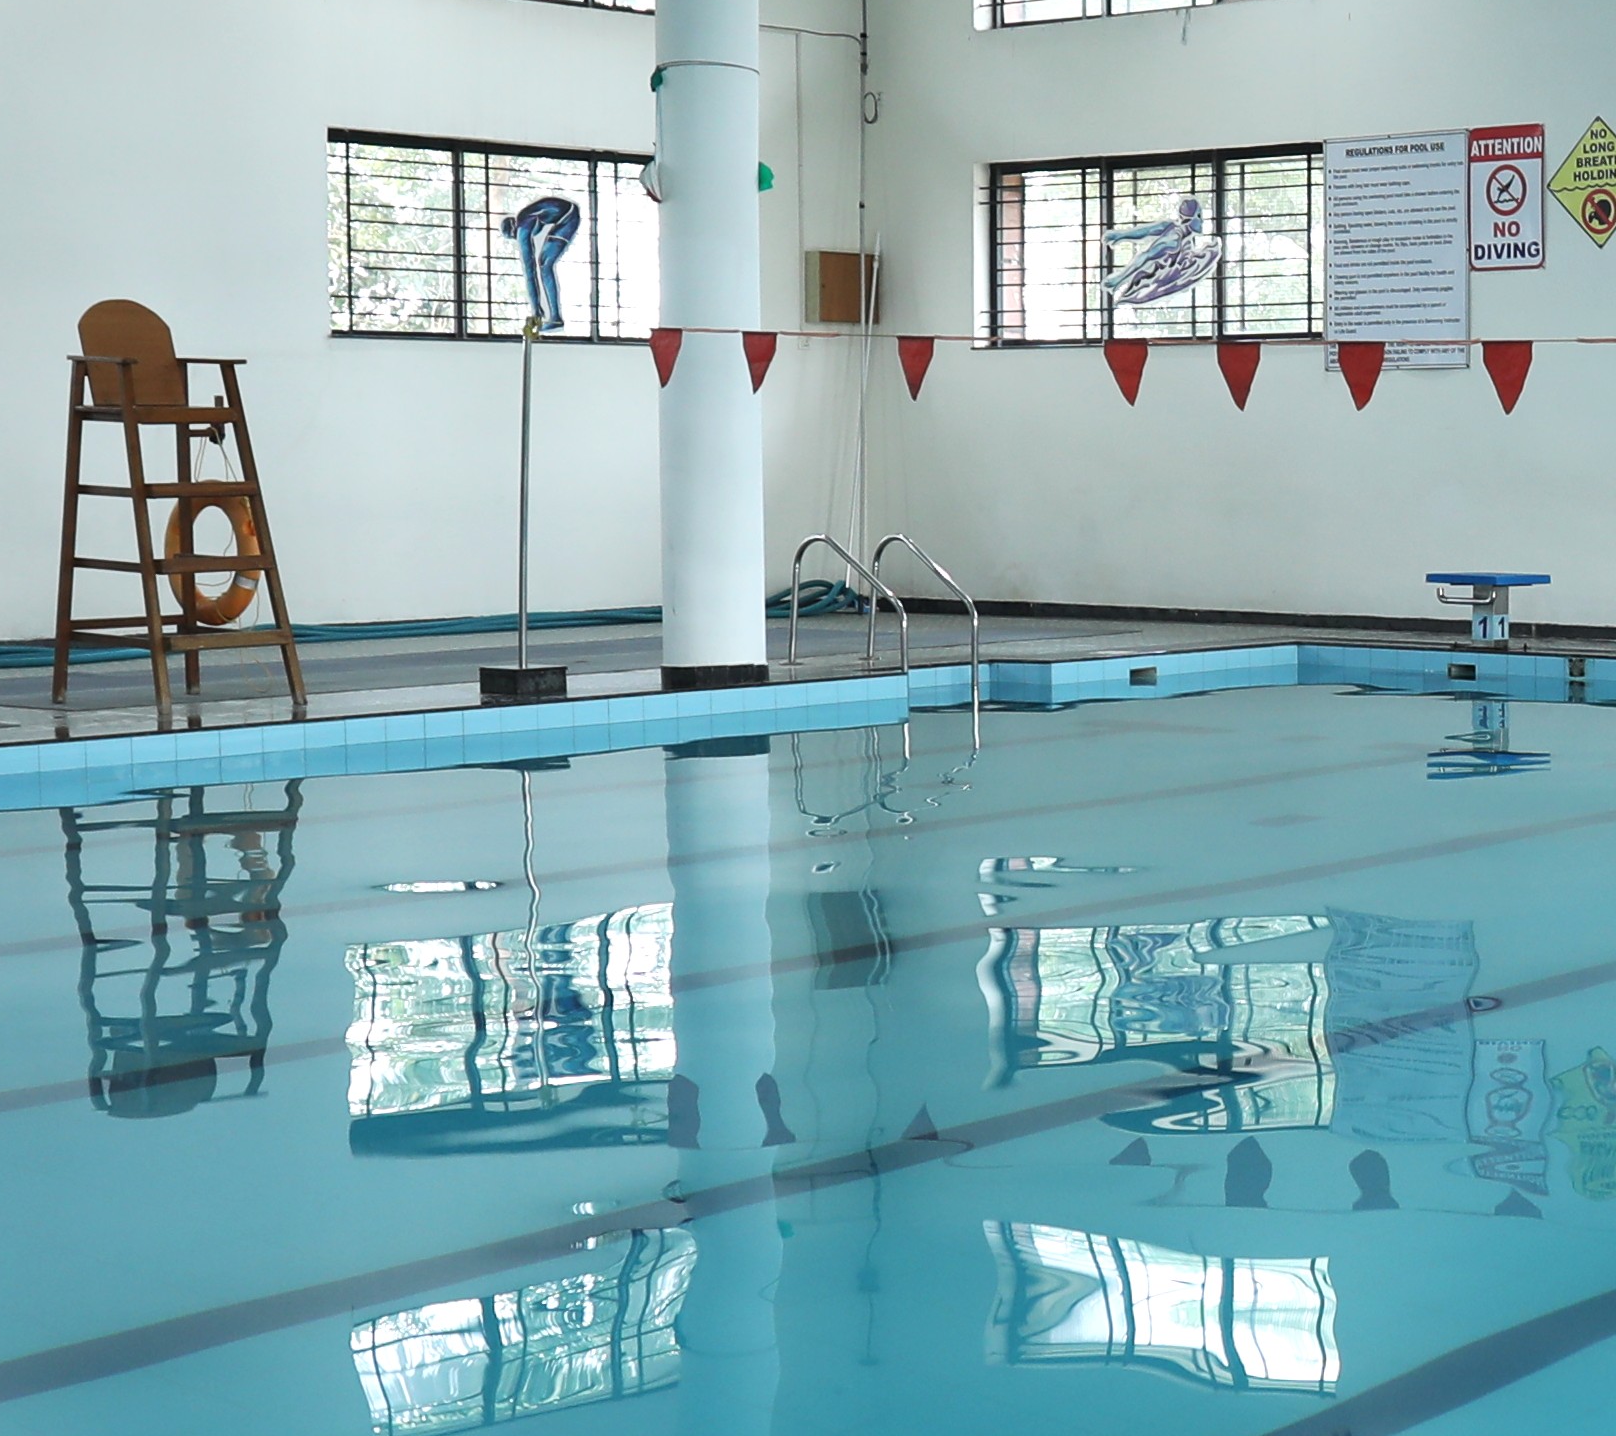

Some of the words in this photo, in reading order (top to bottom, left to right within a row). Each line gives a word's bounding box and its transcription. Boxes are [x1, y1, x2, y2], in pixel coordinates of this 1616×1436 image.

[1590, 128, 1607, 139] NO
[1345, 146, 1393, 157] REGULATIONS
[1395, 145, 1408, 154] FOR
[1410, 144, 1428, 153] POOL
[1430, 142, 1444, 151] USE
[1471, 135, 1542, 156] ATTENTION
[1583, 140, 1615, 153] LONG
[1493, 220, 1520, 238] NO
[1474, 241, 1540, 261] DIVING
[1478, 616, 1489, 639] 1
[1497, 616, 1505, 638] 1
